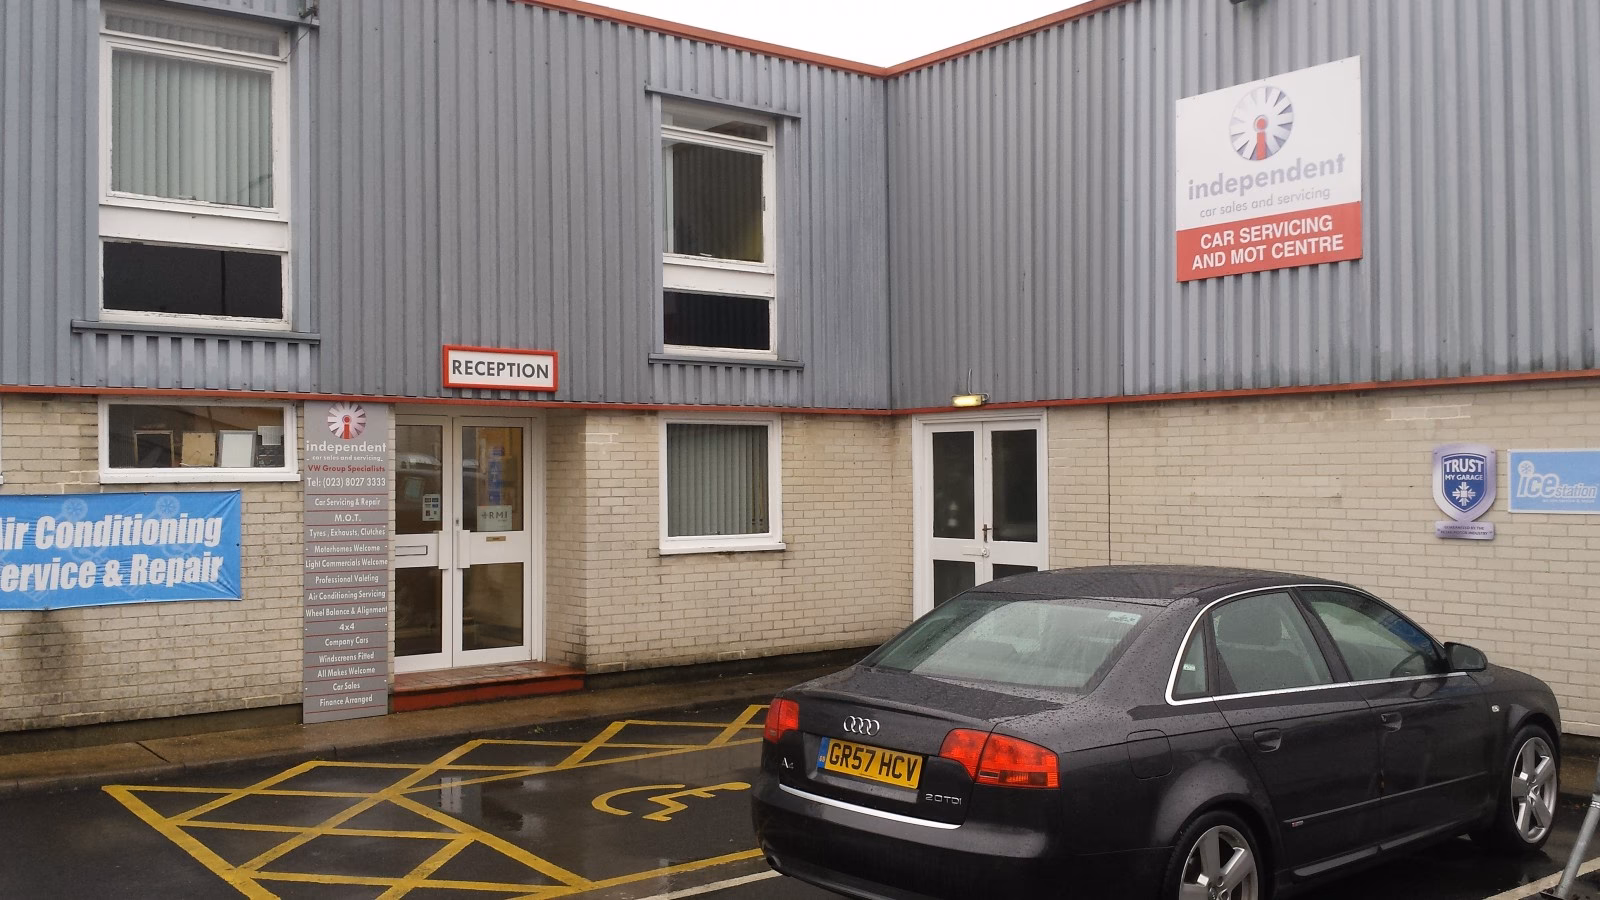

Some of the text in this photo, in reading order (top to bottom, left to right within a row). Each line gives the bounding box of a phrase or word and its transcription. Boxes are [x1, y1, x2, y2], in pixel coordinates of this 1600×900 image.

[1188, 153, 1346, 200] independent
[1200, 188, 1330, 218] car sales and servicing
[1200, 215, 1333, 249] CAR SERVICING
[1191, 234, 1344, 270] AND MOT CENTRE
[452, 359, 549, 379] RECEPTION
[306, 441, 387, 454] independent
[322, 465, 346, 473] Group
[347, 465, 385, 473] Specialists
[1443, 458, 1484, 473] TRUST
[307, 477, 386, 488] Tel: (023) 8027 3333
[314, 498, 325, 506] Car
[327, 498, 354, 507] Servicing
[361, 498, 380, 507] Repair
[334, 514, 362, 522] M.O.T.
[0, 513, 223, 550] ir Conditioning
[360, 528, 386, 536] Clutches
[314, 544, 380, 553] Motorhomes Welcome
[305, 558, 388, 570] Light Commercials Welcome
[0, 552, 224, 592] ervice & Repair
[315, 574, 379, 584] Professional Valeting
[319, 591, 357, 602] Conditioning
[359, 590, 386, 598] Servicing
[305, 609, 325, 617] Wheel
[325, 608, 350, 616] Balance
[357, 606, 388, 616] Alignment
[339, 623, 355, 631] 4x4
[325, 636, 369, 648] Company Cars
[319, 652, 374, 663] Windscreens Fitted
[317, 667, 376, 678] All Makes Welcome
[333, 682, 360, 691] Car Sales
[320, 694, 373, 707] Finance Arranged
[829, 742, 919, 782] GR57 HCV
